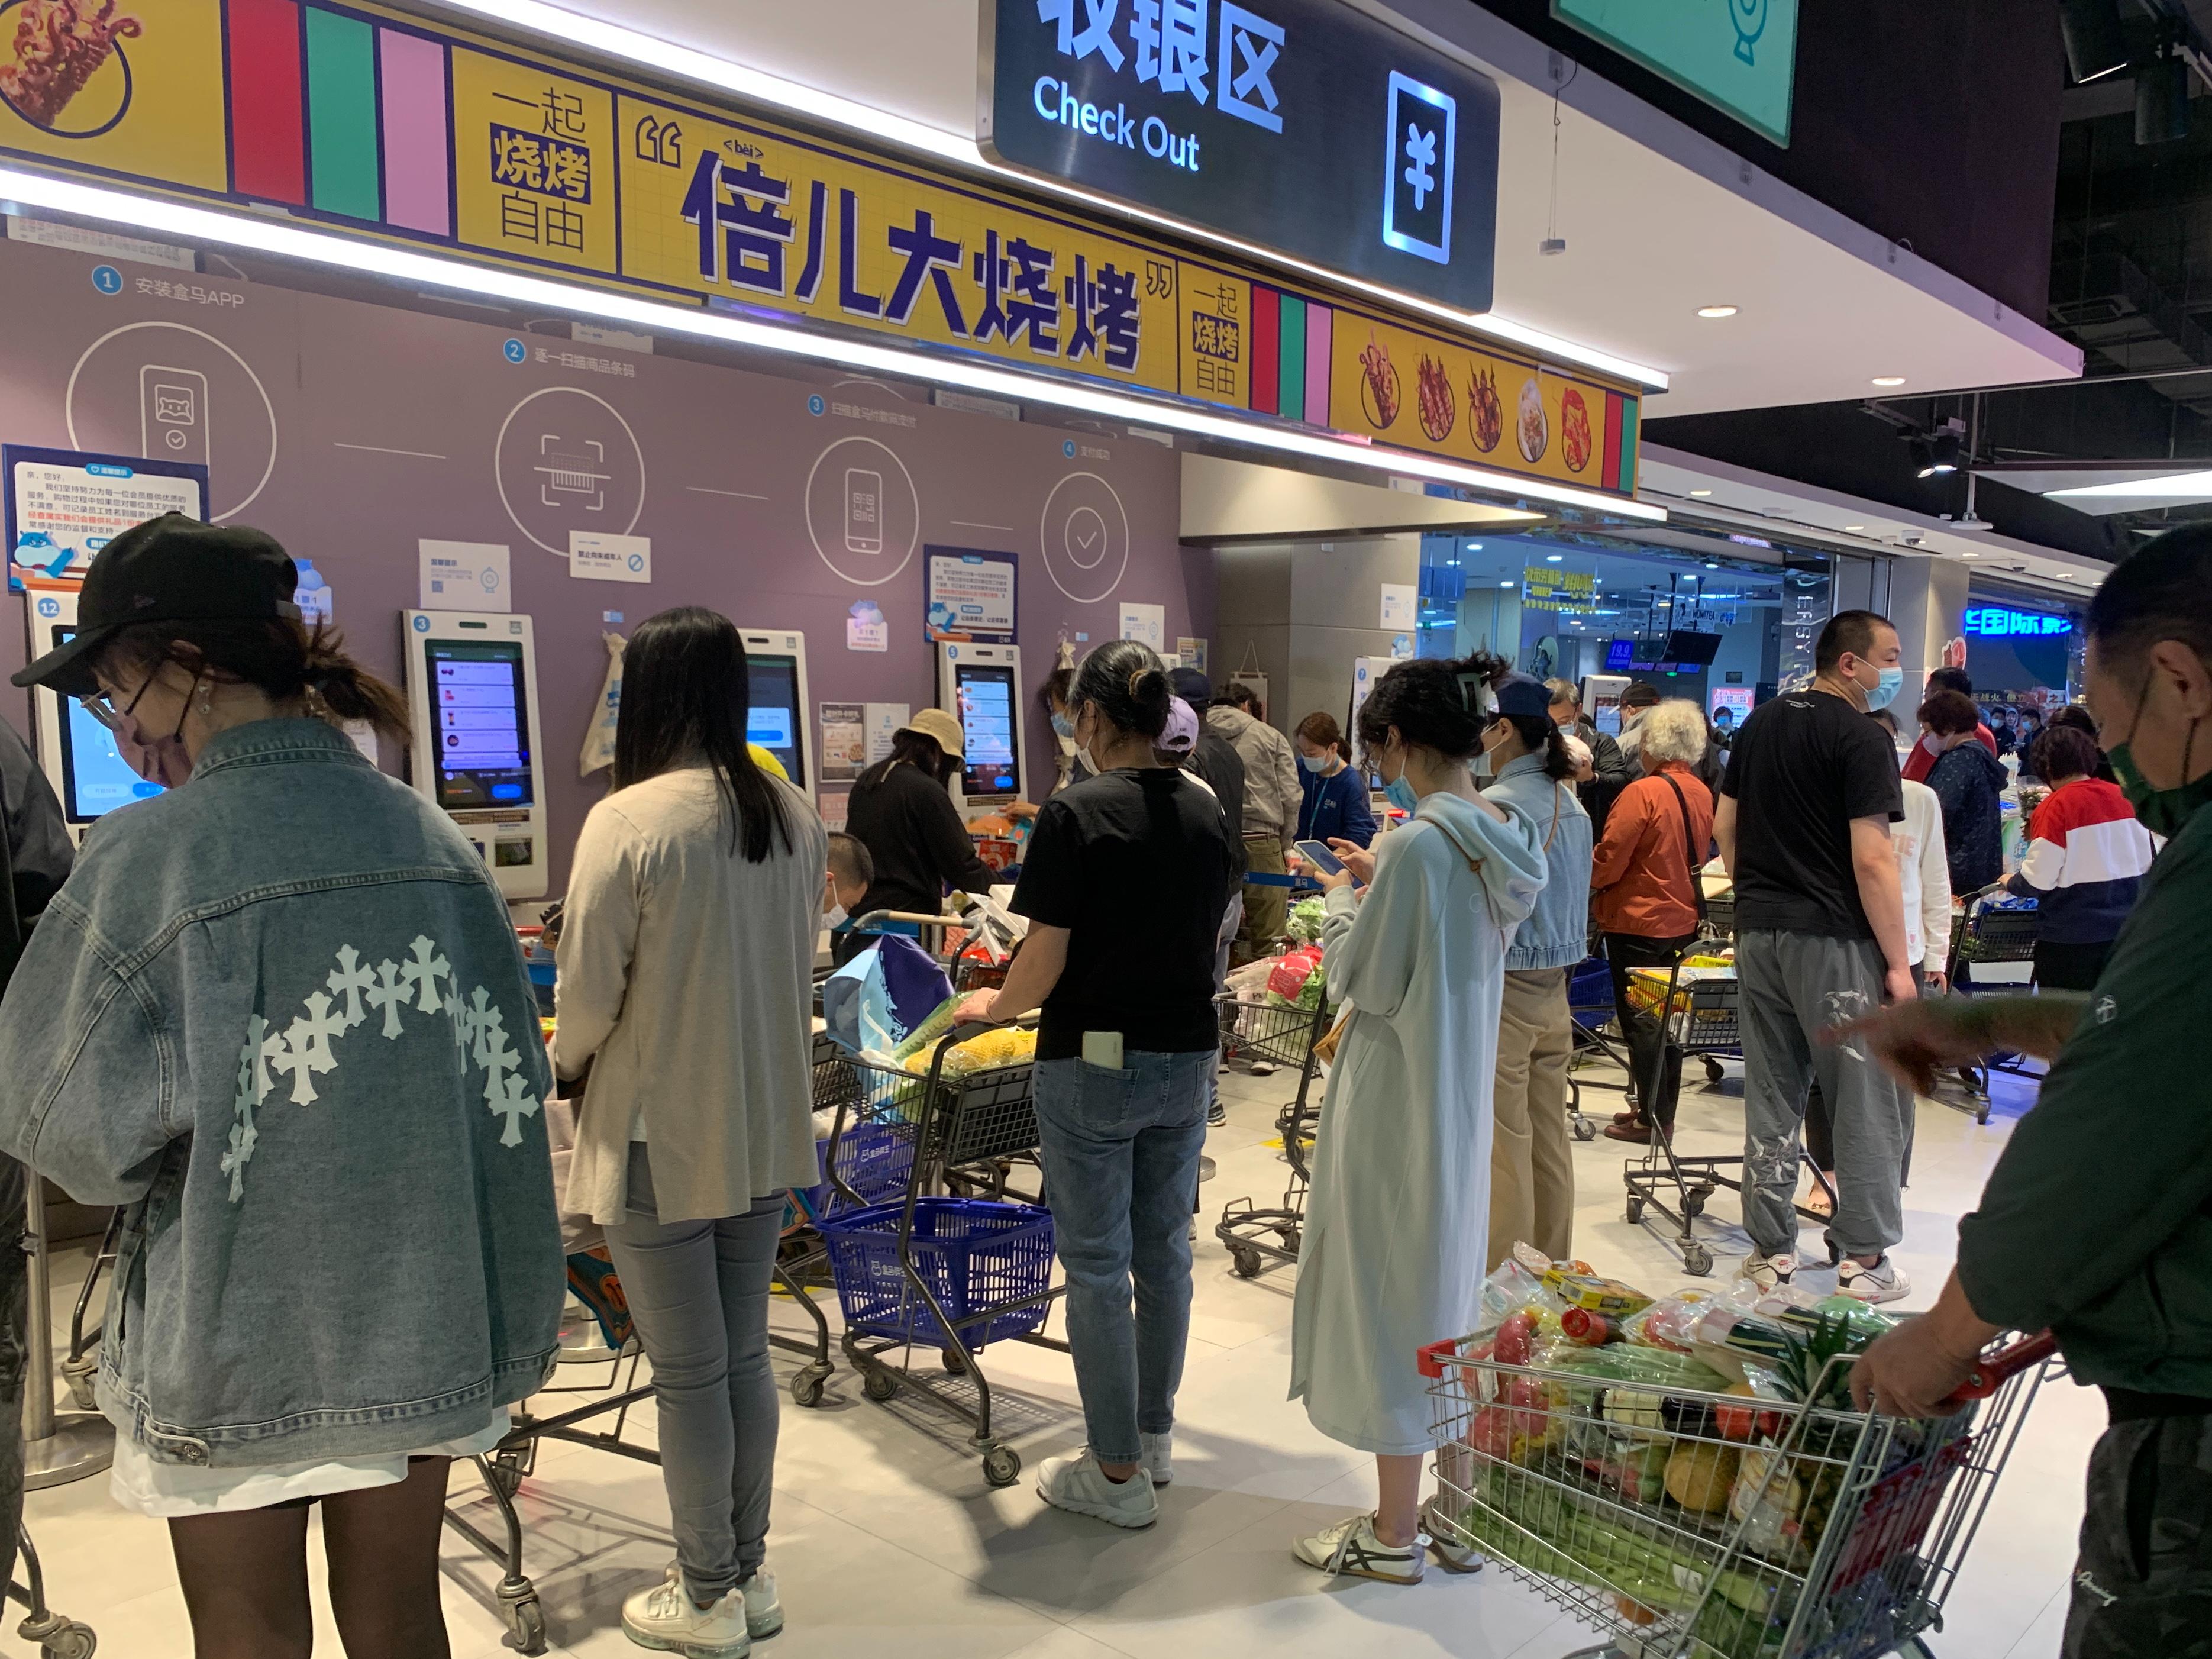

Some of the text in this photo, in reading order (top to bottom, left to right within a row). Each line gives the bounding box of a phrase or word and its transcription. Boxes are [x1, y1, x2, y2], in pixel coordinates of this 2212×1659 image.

[492, 86, 586, 144] 一起
[1034, 76, 1200, 172] Check Out
[493, 129, 589, 200] 烧烤
[502, 189, 584, 253] 自由
[136, 276, 244, 309] 安装盒马APP
[1193, 283, 1238, 319] 一起
[1193, 314, 1239, 362] 烧烤
[534, 347, 635, 378] 逐一扫描商品条码
[1196, 360, 1235, 398] 自由
[41, 602, 58, 614] 12
